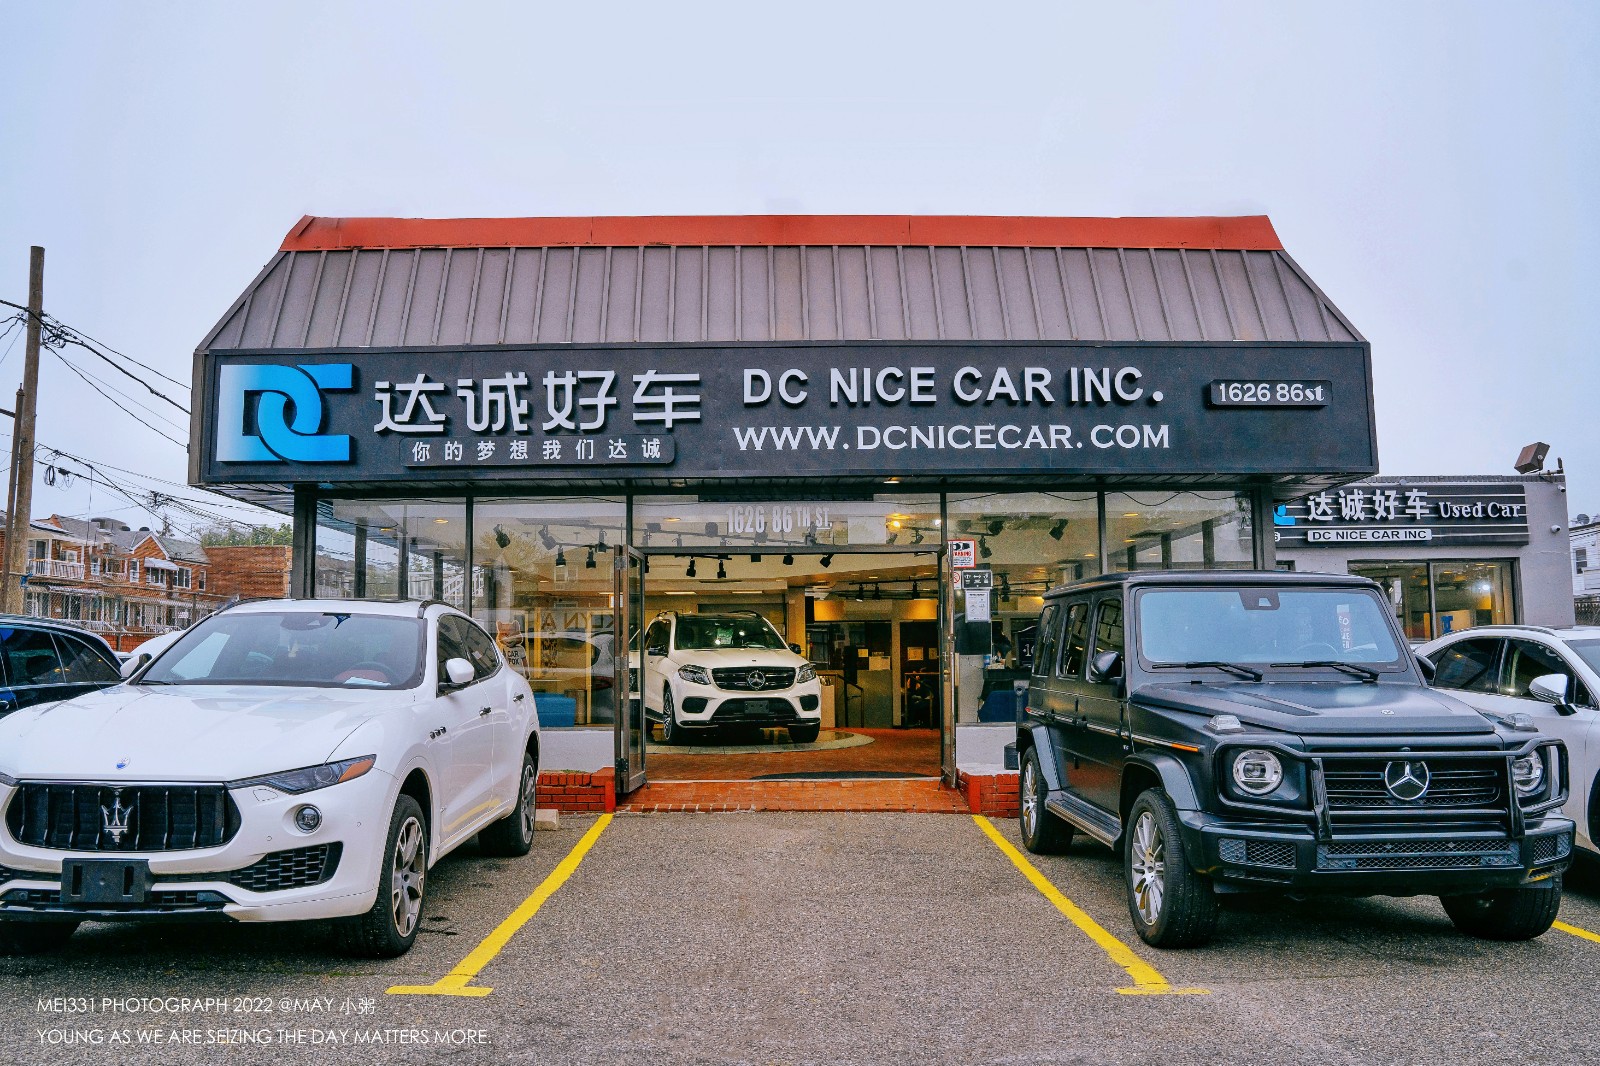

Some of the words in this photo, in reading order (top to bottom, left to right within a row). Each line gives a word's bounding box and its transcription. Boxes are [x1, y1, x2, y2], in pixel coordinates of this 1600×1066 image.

[743, 368, 809, 404] DC
[829, 366, 937, 404] NICE
[953, 366, 1055, 402] CAR
[1070, 366, 1164, 402] INC.
[1219, 382, 1271, 402] 1626
[1276, 382, 1325, 402] 86st
[216, 363, 353, 463] DC
[373, 369, 701, 433] 达诚好车
[411, 437, 662, 463] 你的梦想我们达诚
[1308, 488, 1430, 521] 达诚好车
[1439, 501, 1483, 518] Used
[1488, 501, 1520, 518] Car
[726, 505, 765, 534] 1626
[1312, 531, 1332, 541] DC
[1336, 531, 1367, 540] NICE
[1372, 531, 1400, 540] CAR
[1404, 530, 1427, 539] INC
[507, 650, 519, 658] CAR
[508, 657, 520, 665] FOX
